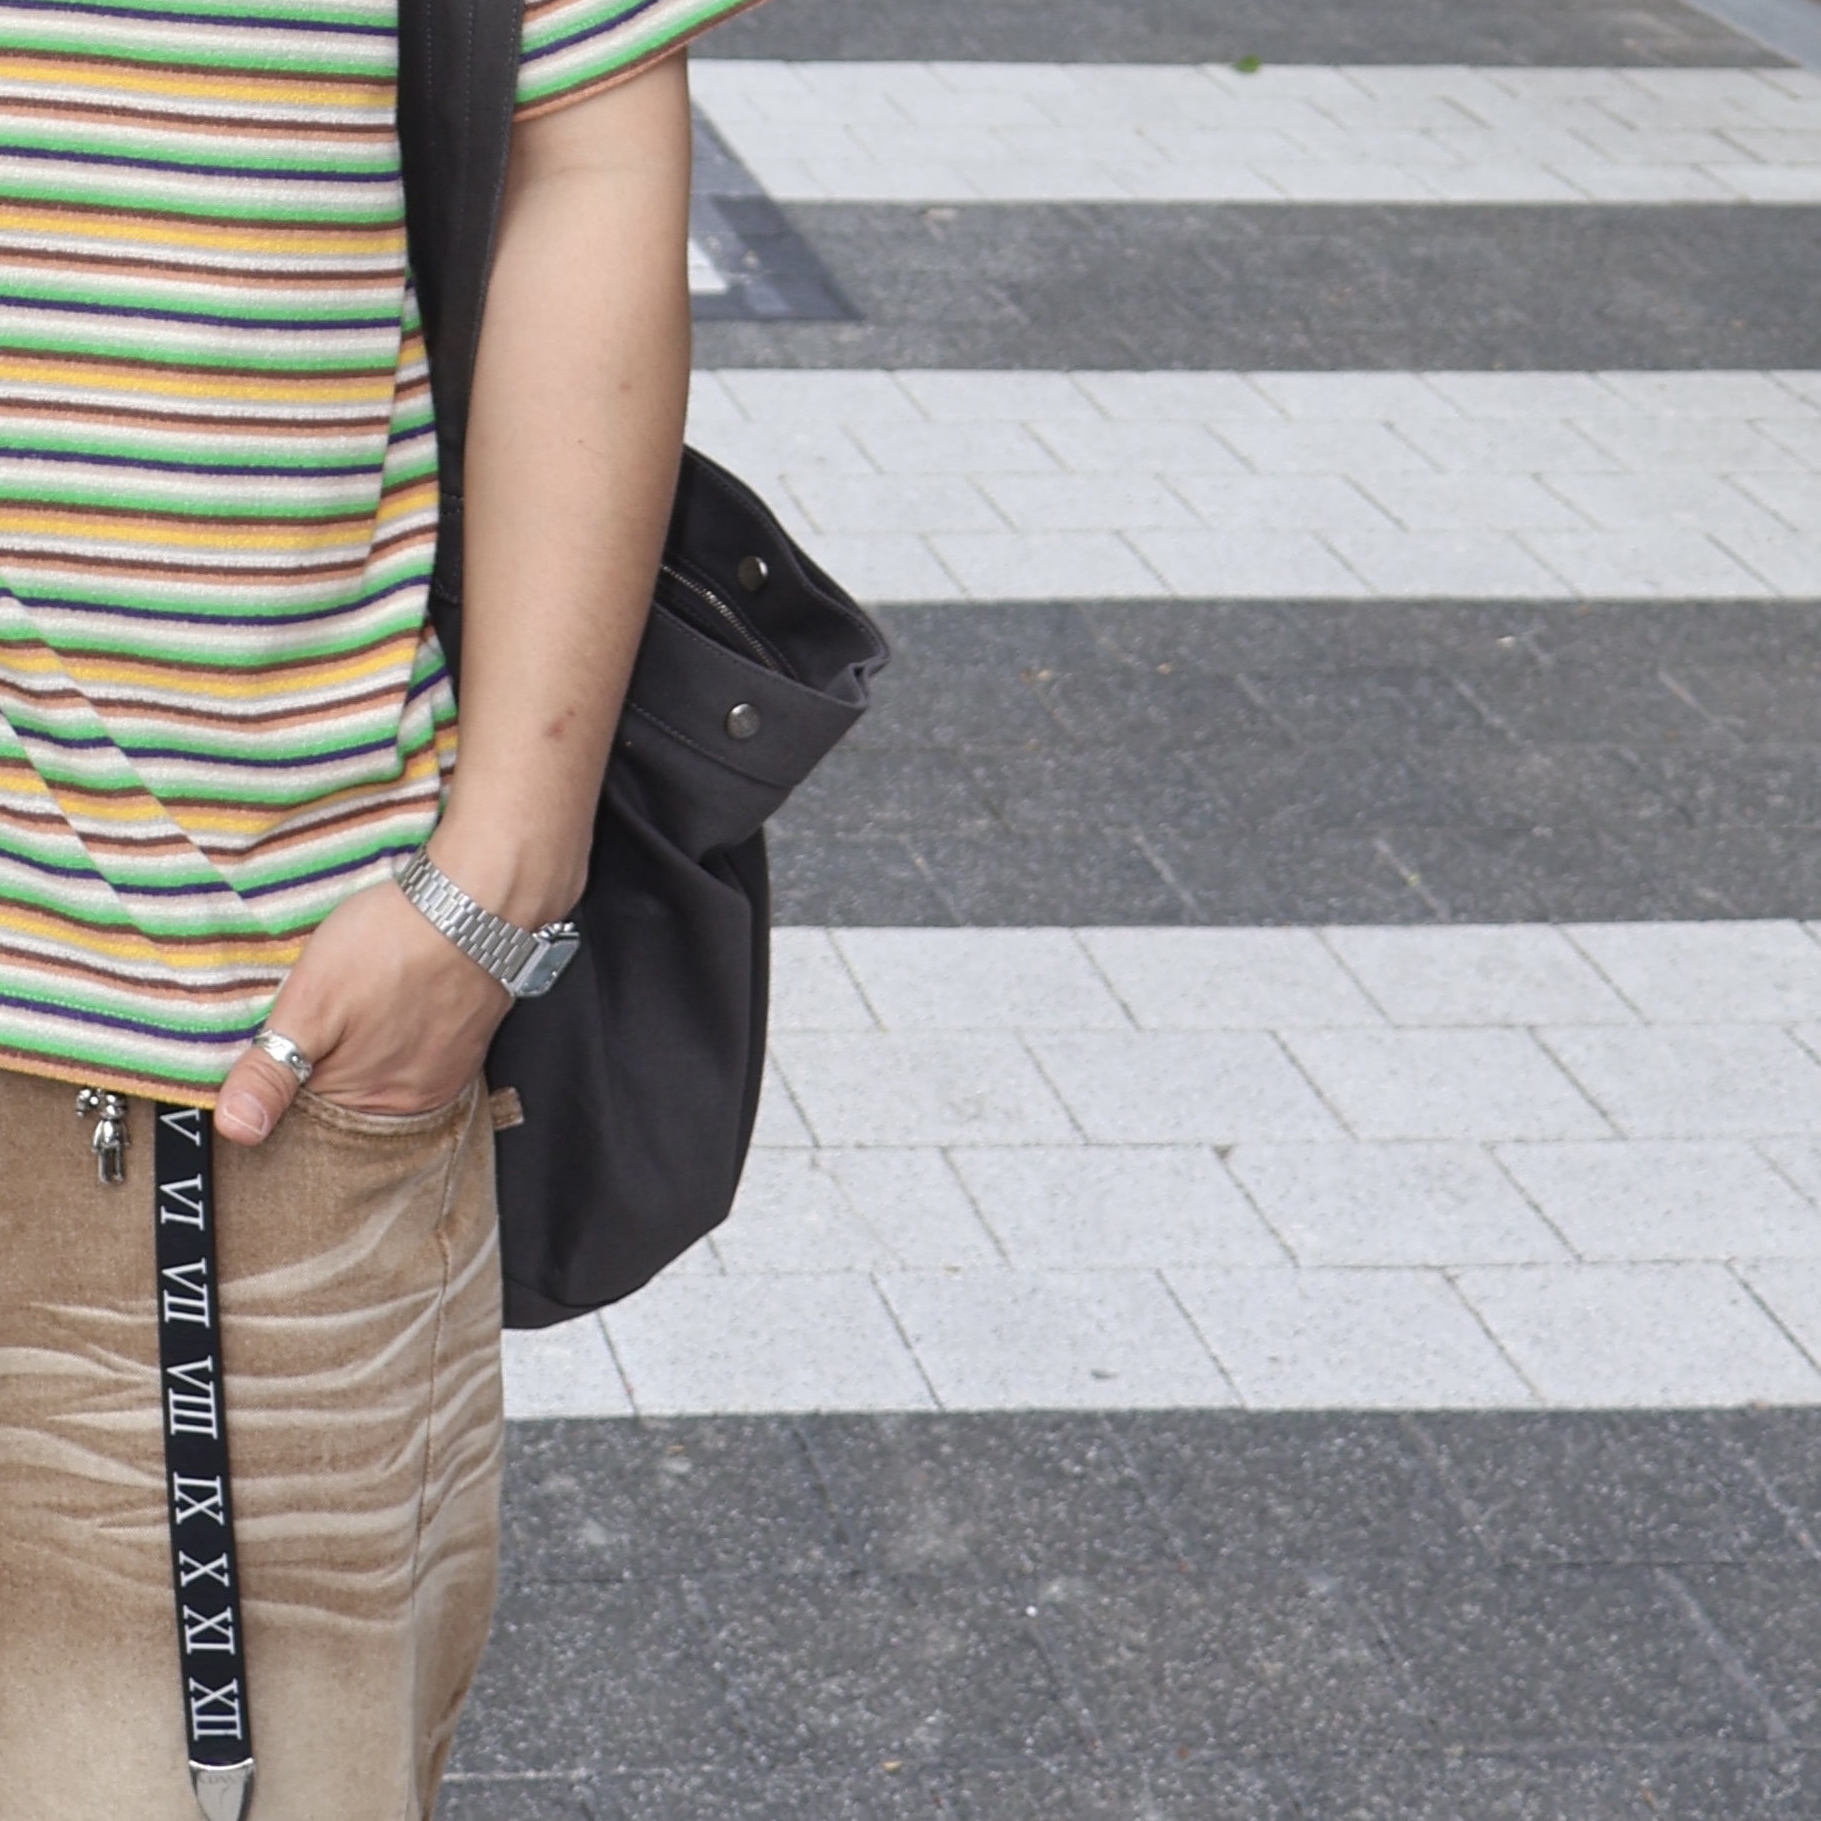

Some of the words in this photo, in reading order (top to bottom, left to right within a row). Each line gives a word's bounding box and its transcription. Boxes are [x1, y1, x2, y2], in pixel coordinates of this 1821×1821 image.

[159, 1174, 205, 1231] VI
[162, 1258, 210, 1328] VII
[166, 1355, 218, 1439] VIII
[173, 1472, 225, 1525] IX
[179, 1550, 230, 1587] X
[183, 1605, 235, 1654] XI
[189, 1677, 242, 1740] XII
